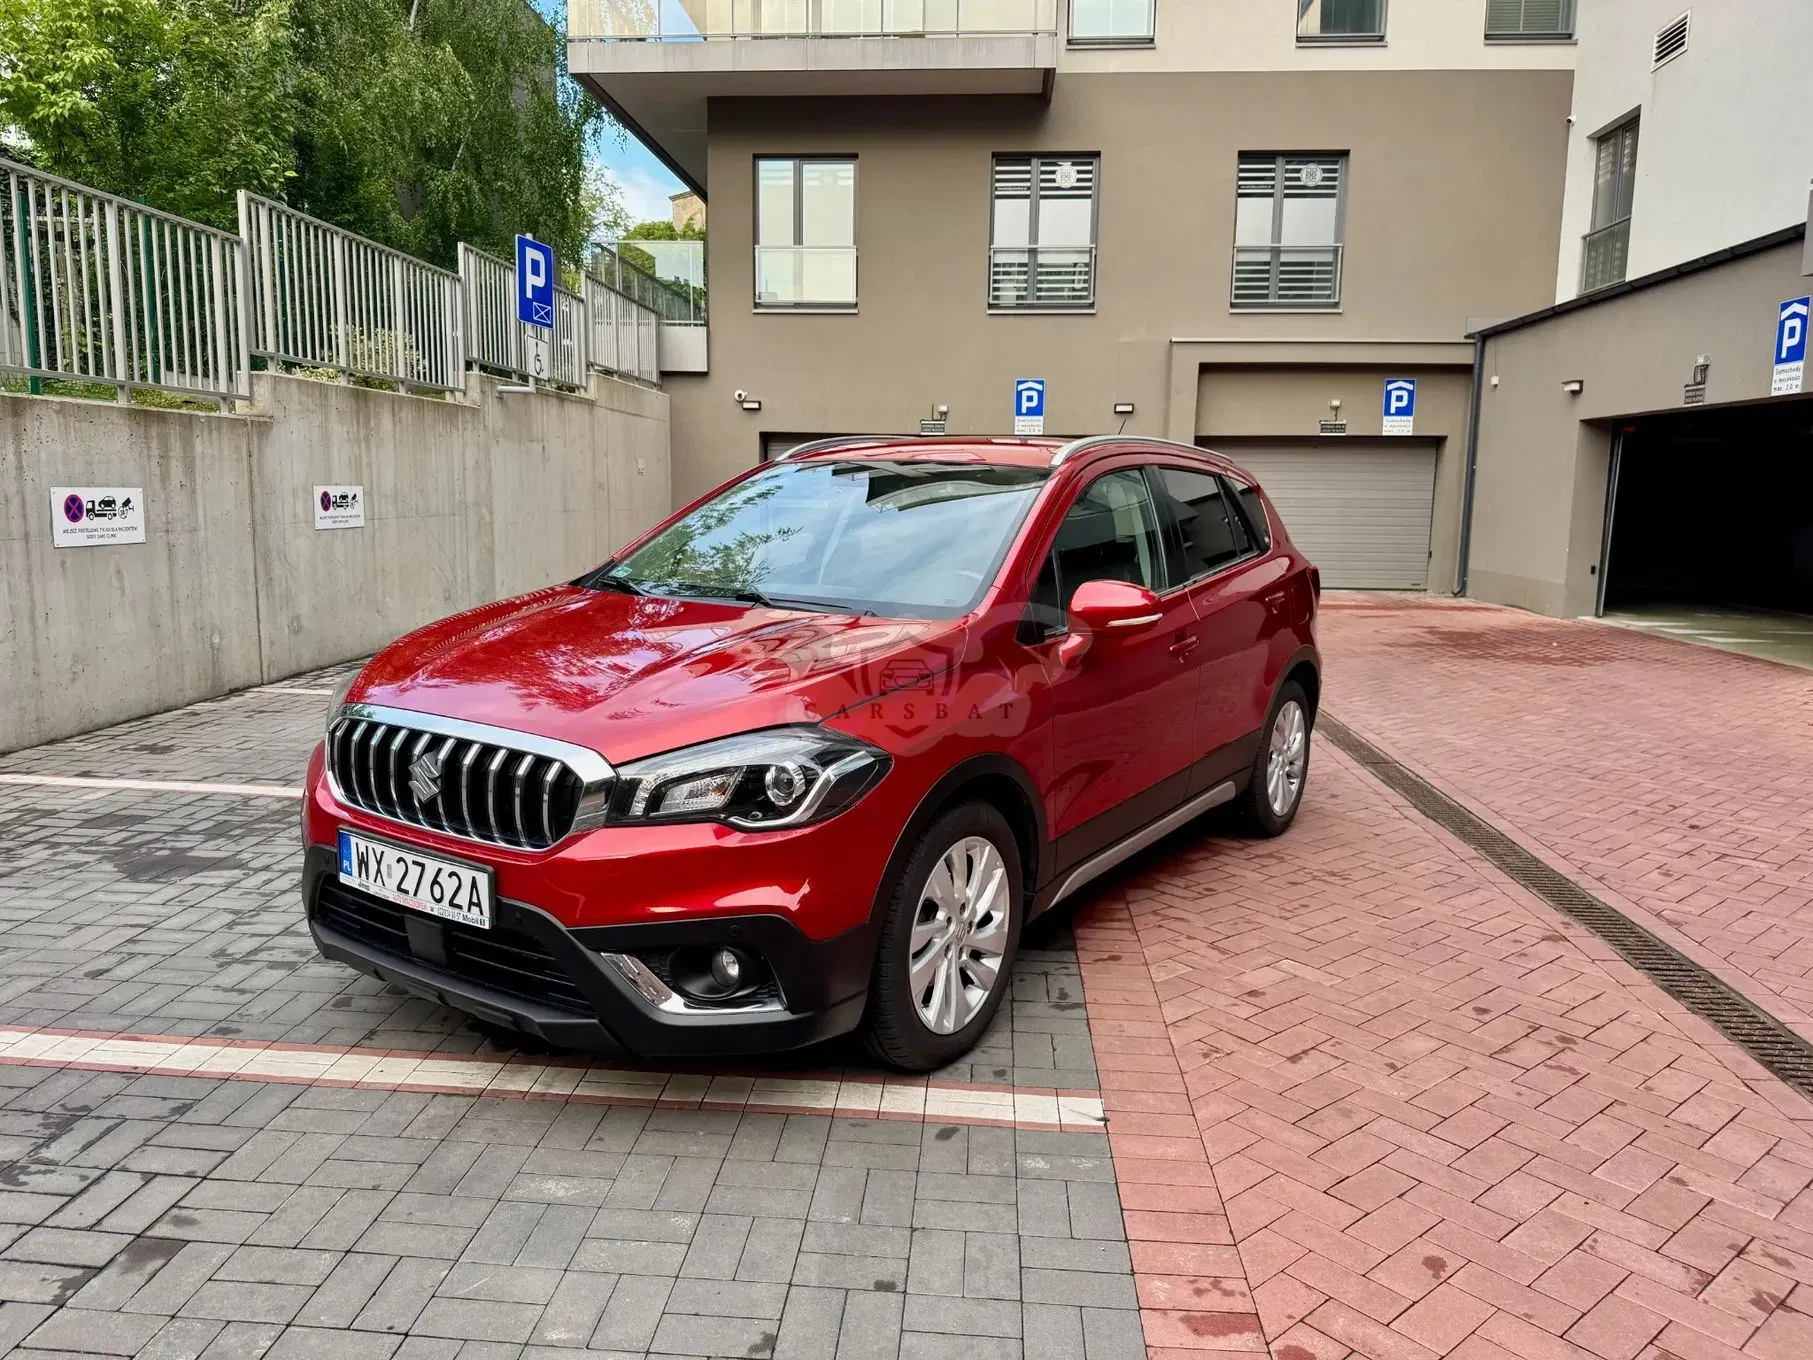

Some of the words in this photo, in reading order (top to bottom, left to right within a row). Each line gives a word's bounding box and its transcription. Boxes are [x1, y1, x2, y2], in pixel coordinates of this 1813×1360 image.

[525, 246, 546, 299] P
[1781, 317, 1801, 359] P
[1021, 390, 1039, 414] P
[1389, 390, 1408, 414] P
[343, 861, 351, 872] PL
[355, 842, 386, 887] WX
[396, 856, 484, 916] 2762A
